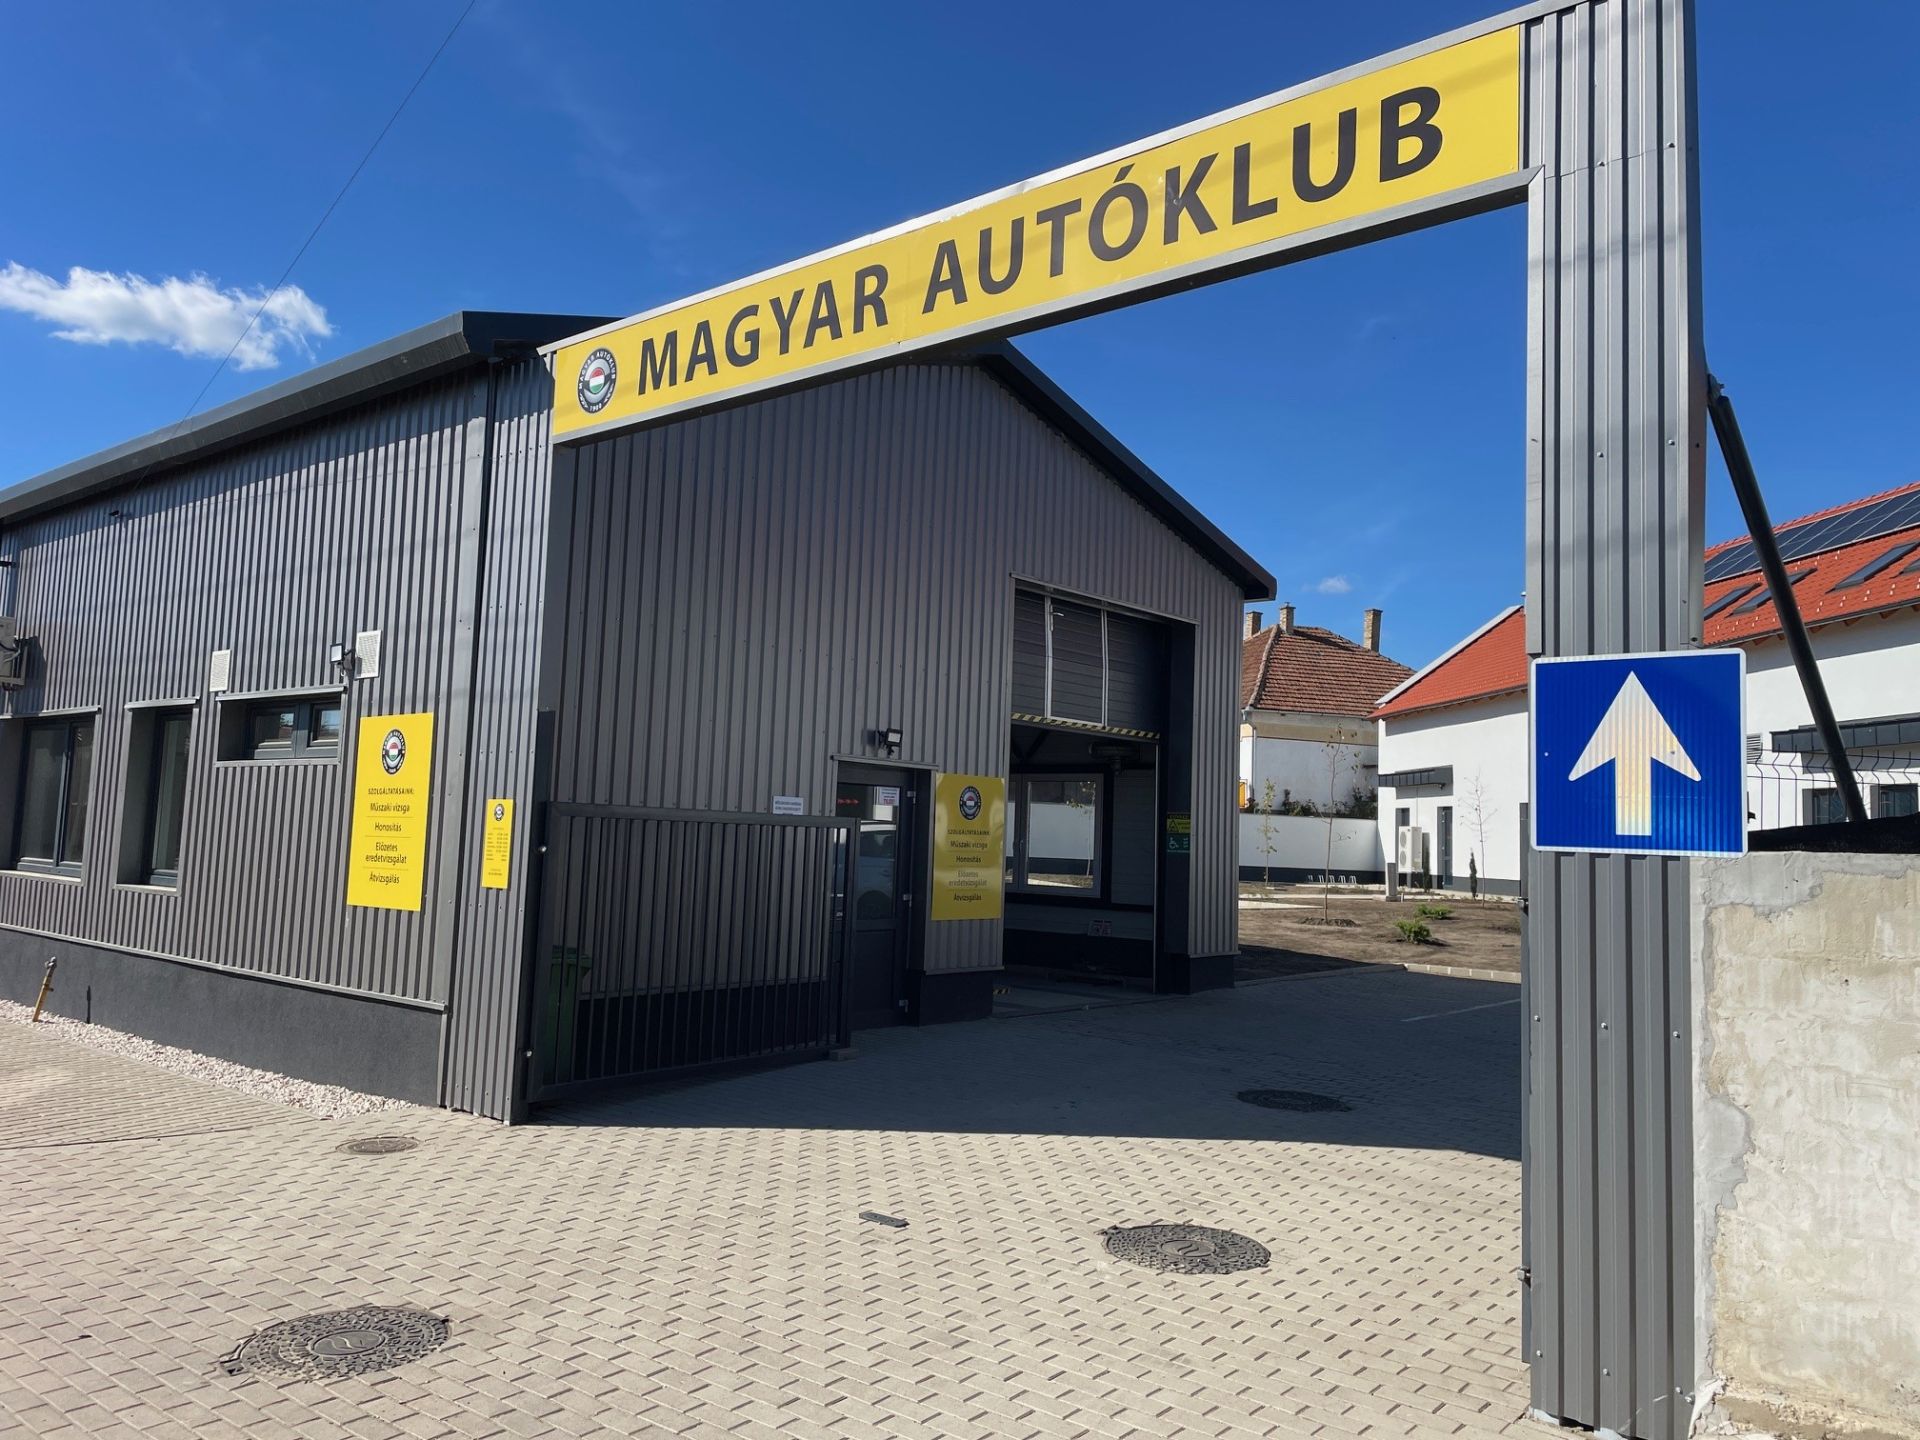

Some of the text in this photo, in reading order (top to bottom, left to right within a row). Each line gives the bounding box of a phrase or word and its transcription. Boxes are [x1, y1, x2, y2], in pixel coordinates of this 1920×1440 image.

[638, 86, 1443, 396] MAGYAR AUTÓKLUB
[392, 803, 410, 814] vizsga
